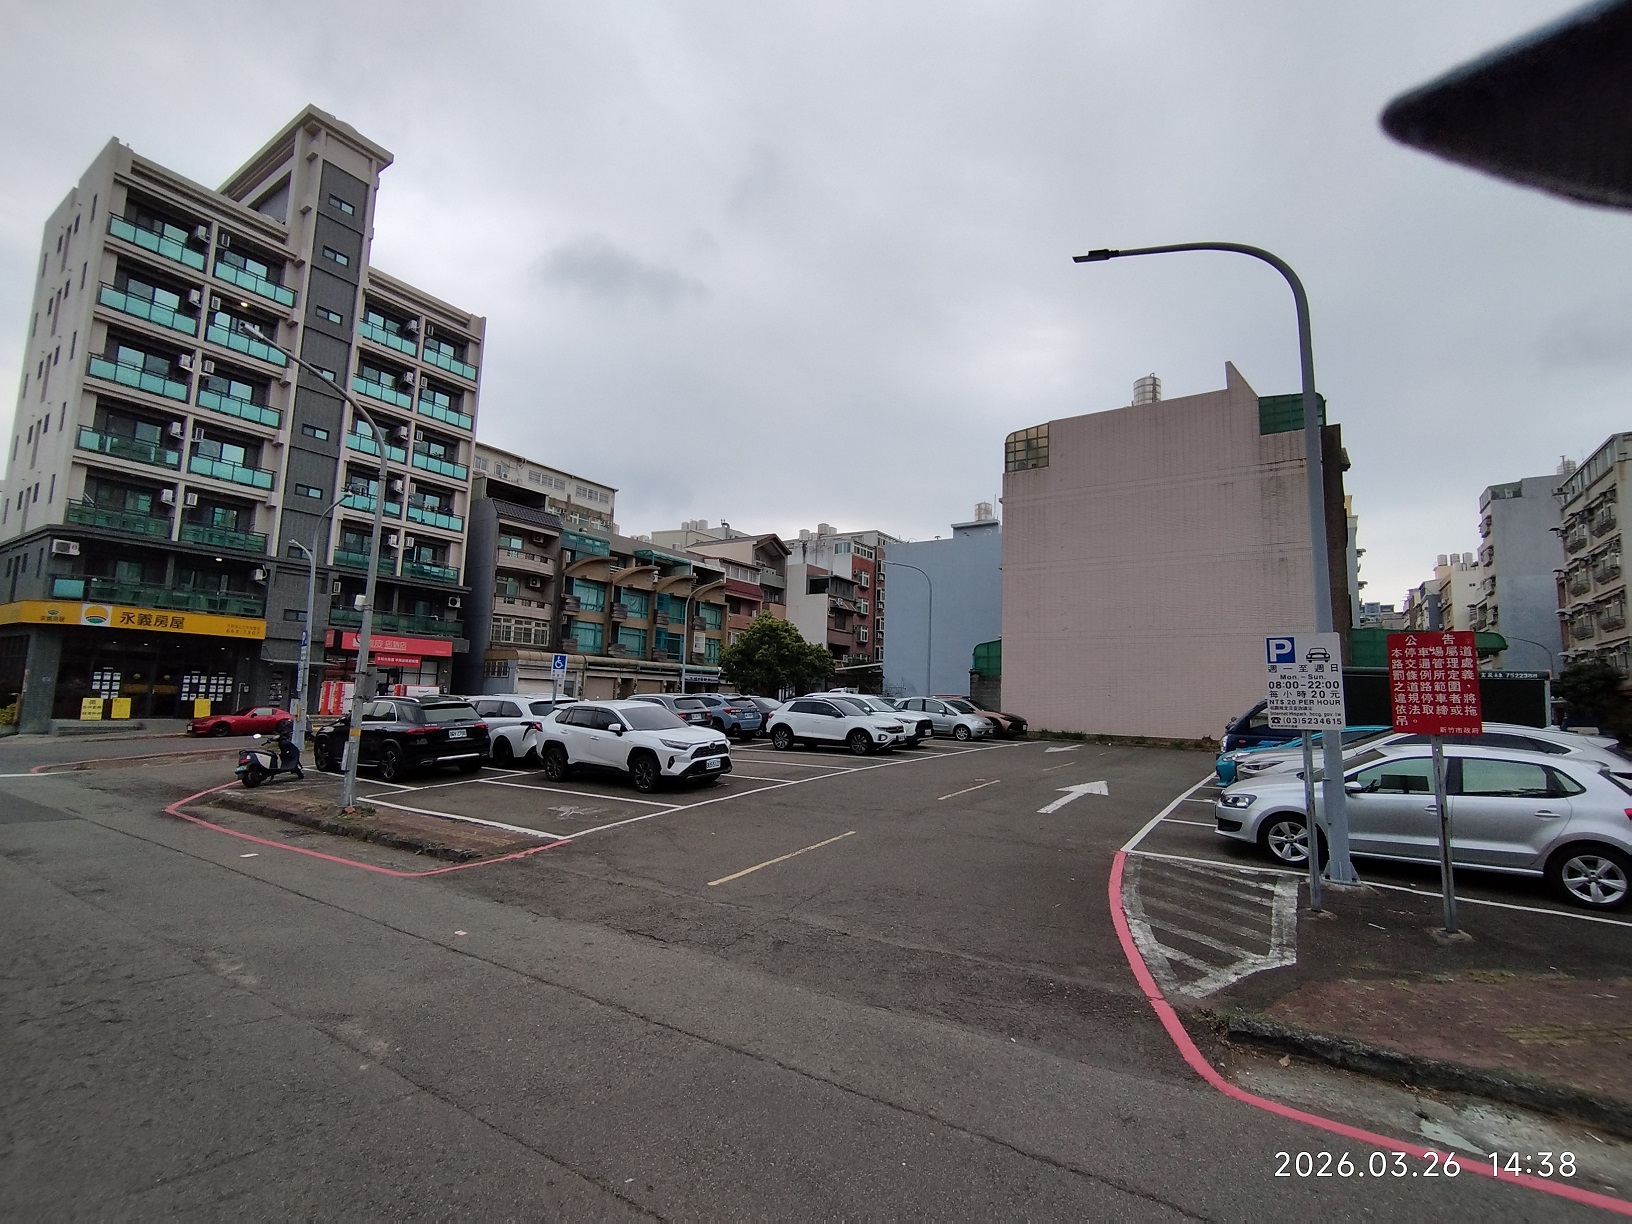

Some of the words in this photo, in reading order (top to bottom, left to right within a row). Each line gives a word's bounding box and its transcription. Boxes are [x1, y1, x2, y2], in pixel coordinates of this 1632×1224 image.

[120, 611, 185, 630] 永義房屋
[1268, 639, 1292, 662] P
[1391, 646, 1473, 658] 本停車場屬道
[1268, 663, 1339, 673] 週一至週日
[1391, 658, 1475, 669] 路交通管理處
[1392, 669, 1475, 681] 罰條例所定義
[1394, 693, 1477, 704] 違規停車者將
[1395, 704, 1479, 717] 依法取締或拖
[1283, 717, 1342, 725] (03)5234615
[1440, 726, 1480, 734] 新竹市政府
